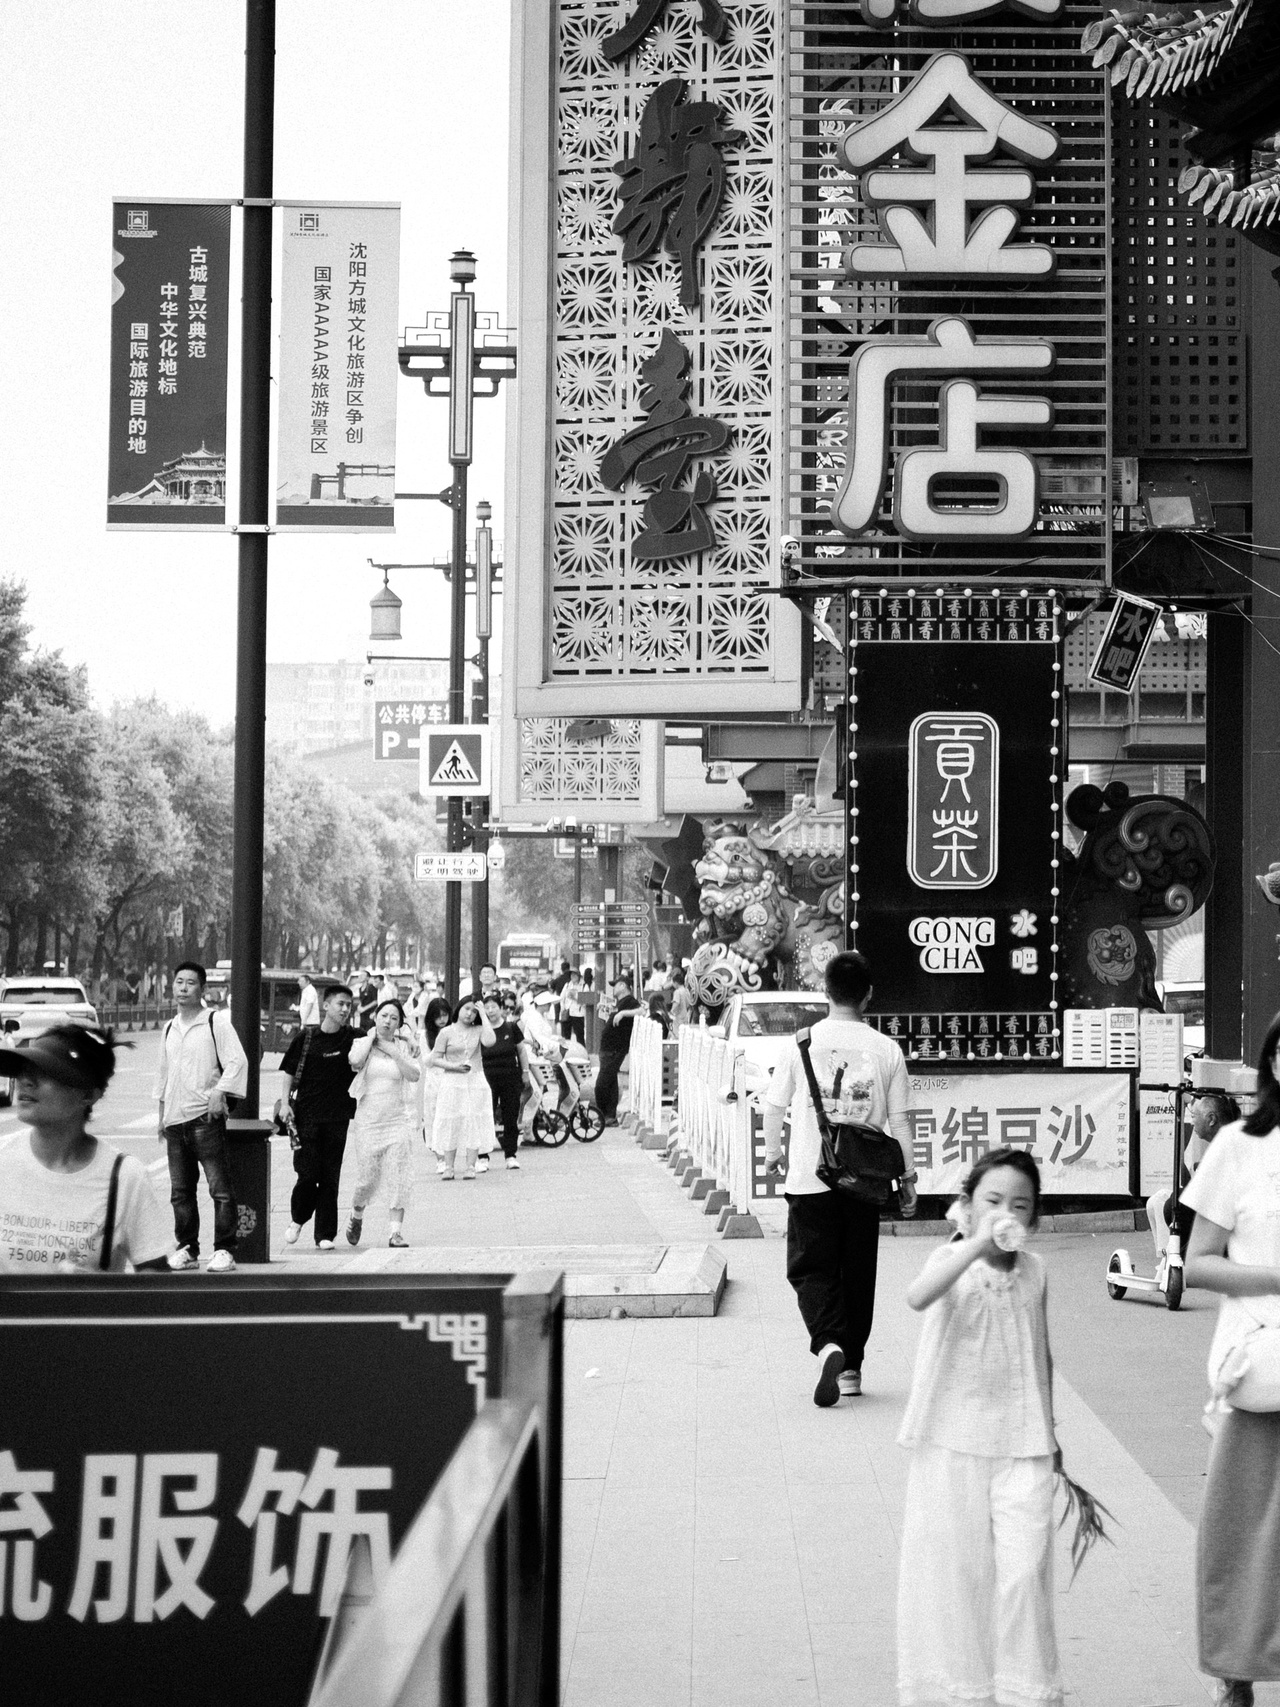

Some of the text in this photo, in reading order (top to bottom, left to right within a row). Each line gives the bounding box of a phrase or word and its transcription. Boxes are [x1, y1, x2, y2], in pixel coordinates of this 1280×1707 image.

[187, 246, 208, 359] 古城复兴典范
[830, 0, 1064, 542] 金店
[158, 282, 179, 395] 中华文化地标
[310, 266, 332, 454] 国家AAAAA级旅游景区
[345, 242, 367, 444] 沈阳方城文化旅游区争创
[127, 323, 149, 455] 国际旅游目的地
[1103, 607, 1148, 683] 水吧
[382, 731, 401, 757] P
[914, 921, 991, 943] GONG
[925, 947, 980, 969] CHA
[1010, 909, 1039, 974] 水吧
[911, 1078, 949, 1090] 名小吃
[1, 1229, 15, 1242] 22
[37, 1234, 96, 1252] MONTAIGNE
[3, 1213, 102, 1234] BONJOUR LIBERTY
[8, 1247, 48, 1263] 75008
